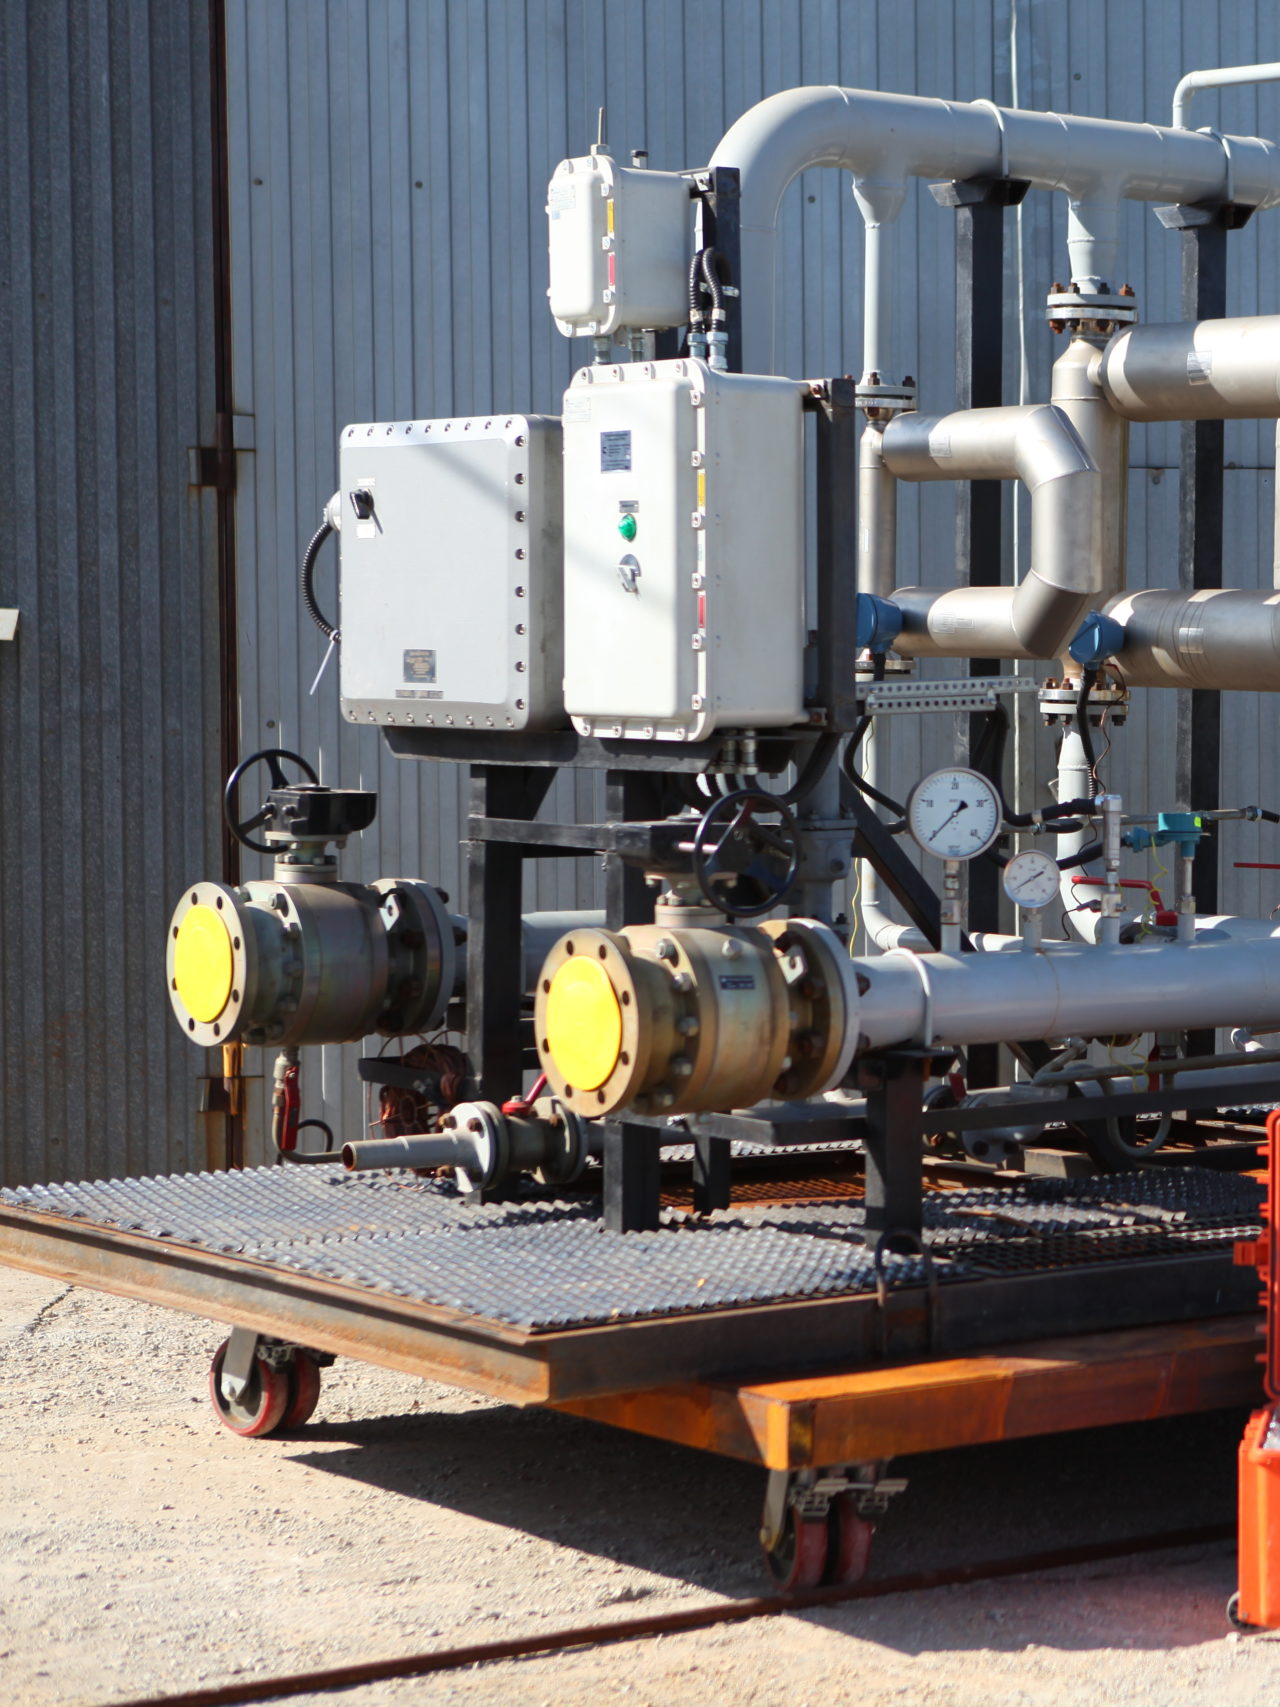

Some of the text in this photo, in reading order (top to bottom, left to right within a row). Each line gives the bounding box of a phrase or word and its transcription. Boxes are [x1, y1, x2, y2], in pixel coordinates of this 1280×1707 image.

[951, 782, 959, 790] 20
[926, 800, 934, 808] 10
[976, 800, 984, 808] 30
